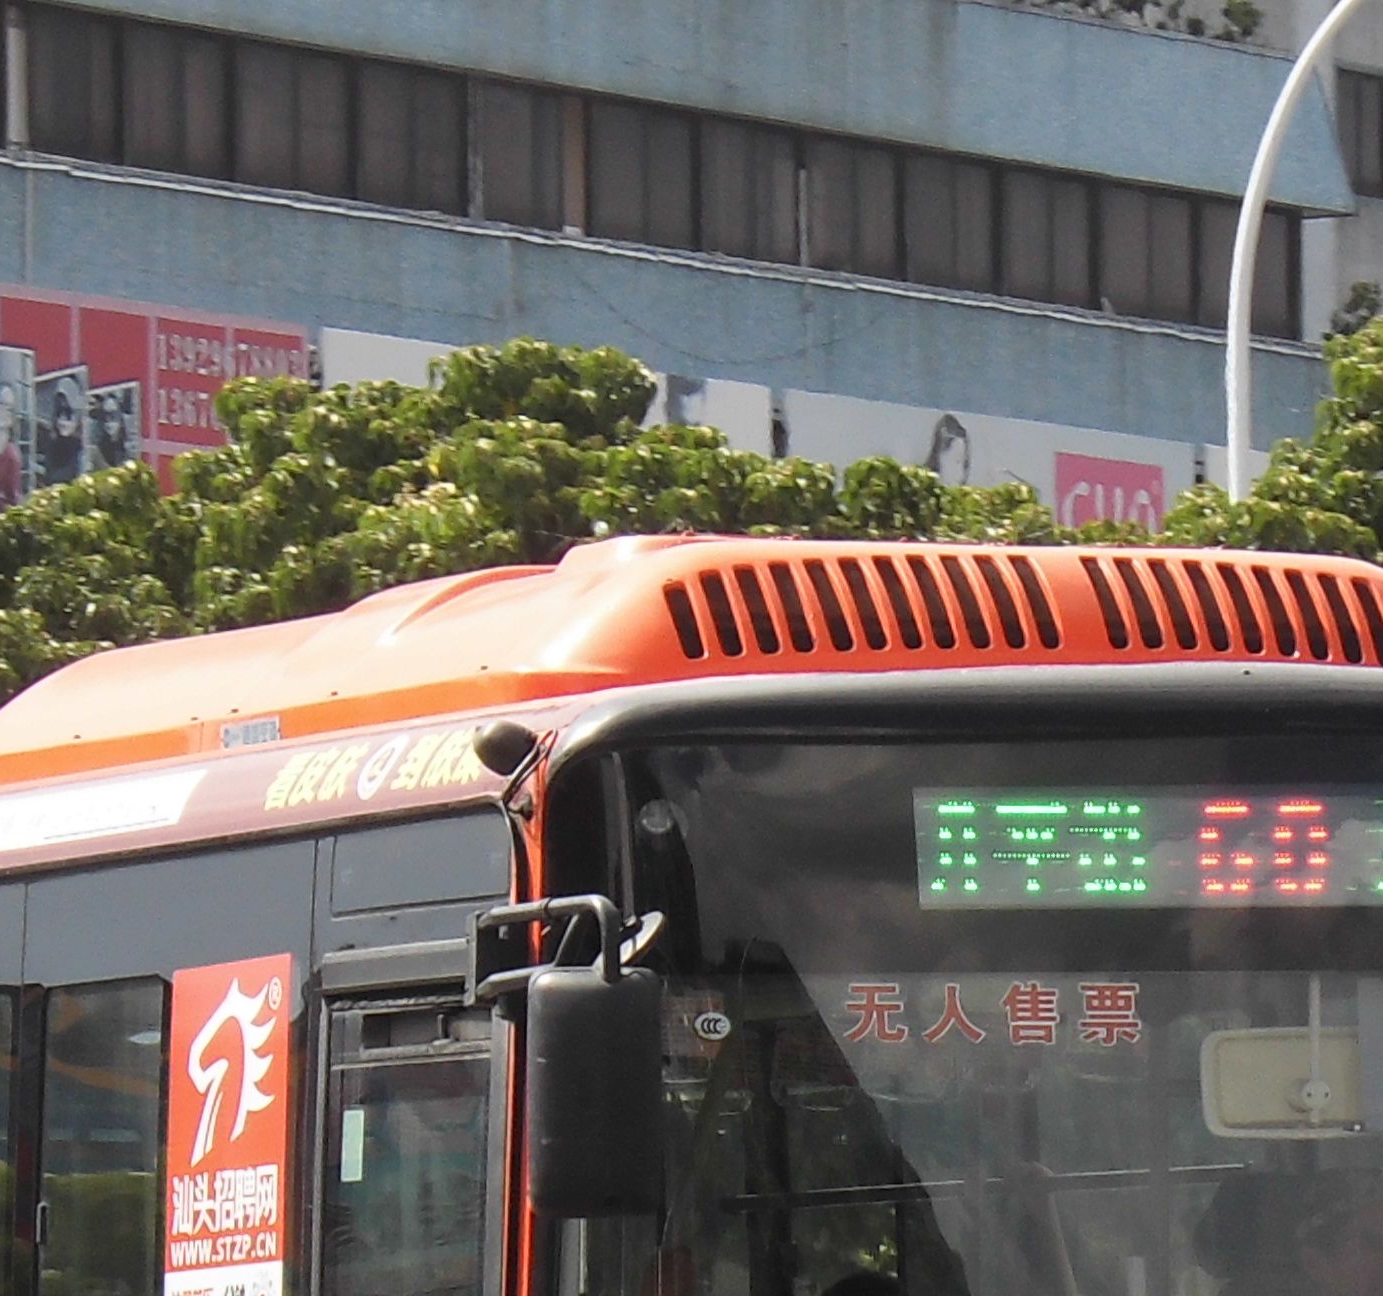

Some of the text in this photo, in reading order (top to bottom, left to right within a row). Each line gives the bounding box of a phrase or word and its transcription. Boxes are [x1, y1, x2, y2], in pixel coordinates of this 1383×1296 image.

[844, 981, 1142, 1046] 无人售票
[171, 1163, 279, 1237] 汕头招聘网
[170, 1232, 277, 1268] WWW.STZP.CN
